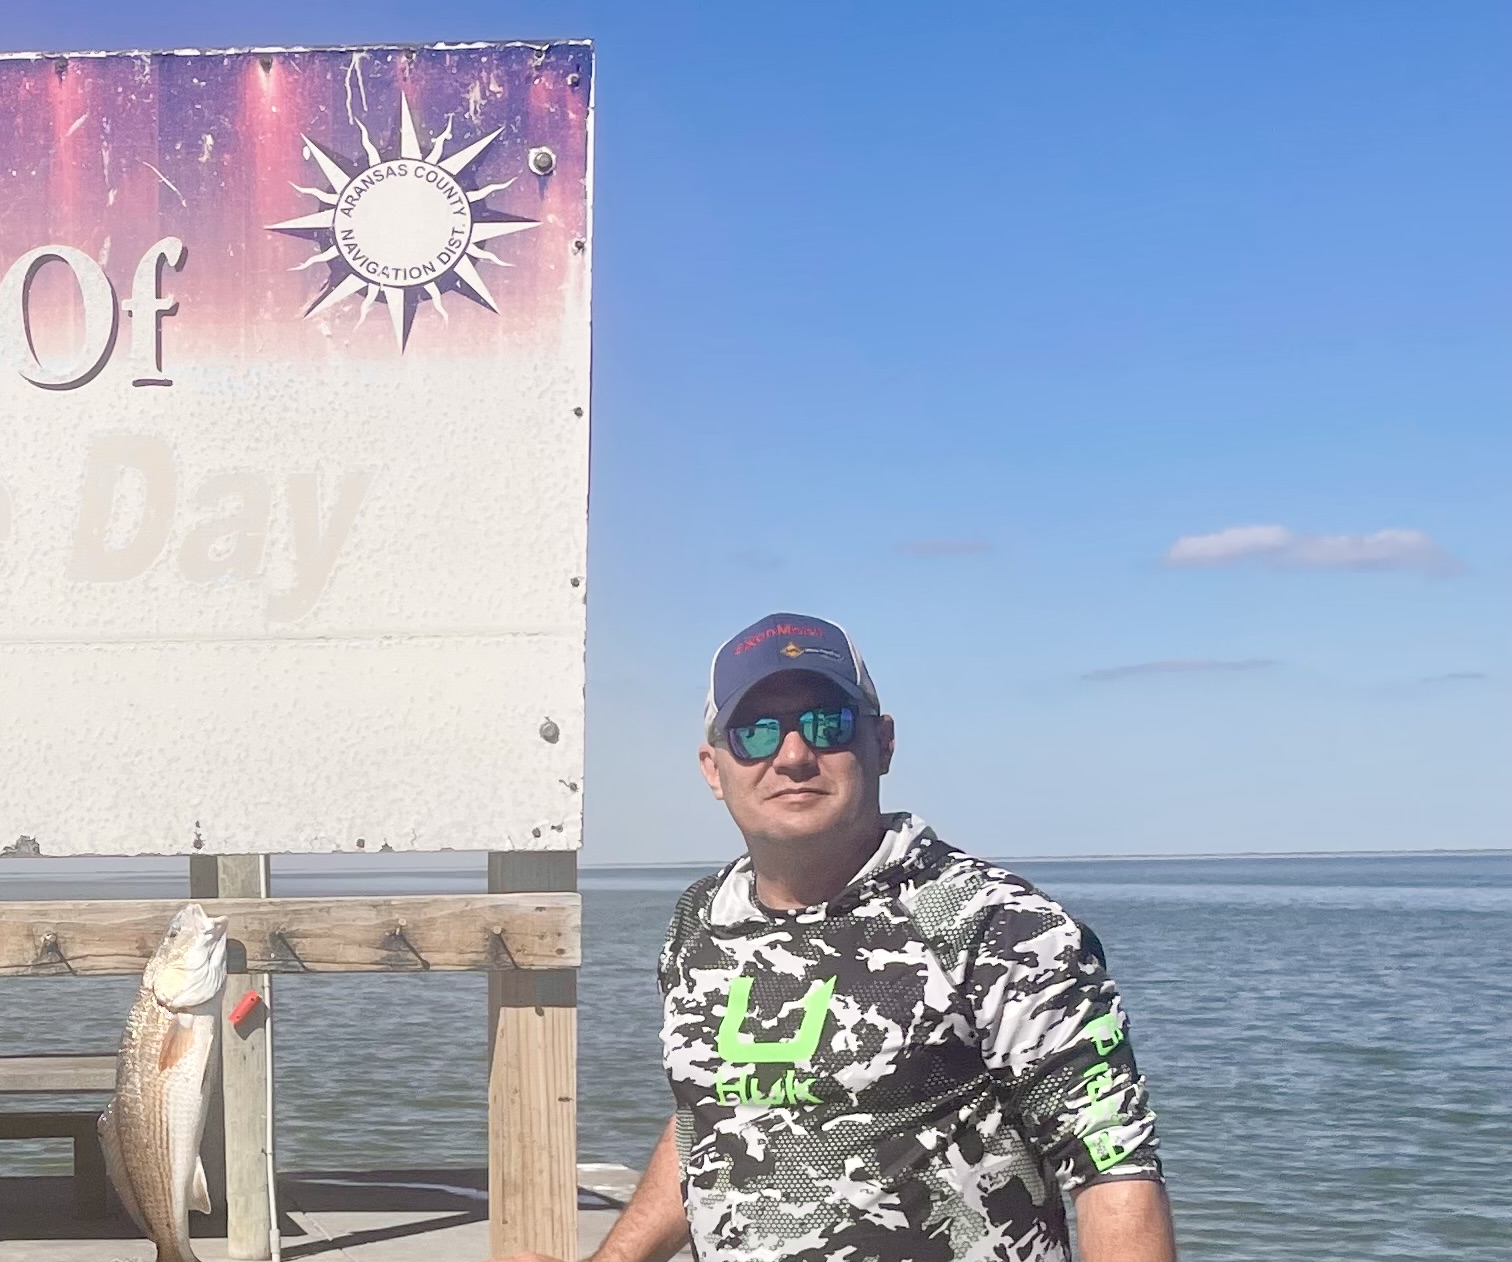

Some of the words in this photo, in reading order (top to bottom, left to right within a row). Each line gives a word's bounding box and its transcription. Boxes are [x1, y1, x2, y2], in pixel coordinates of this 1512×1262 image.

[339, 163, 409, 218] ARANSAS
[414, 165, 467, 217] COUNTY
[340, 229, 437, 281] NAVIGATION
[68, 431, 382, 624] Day
